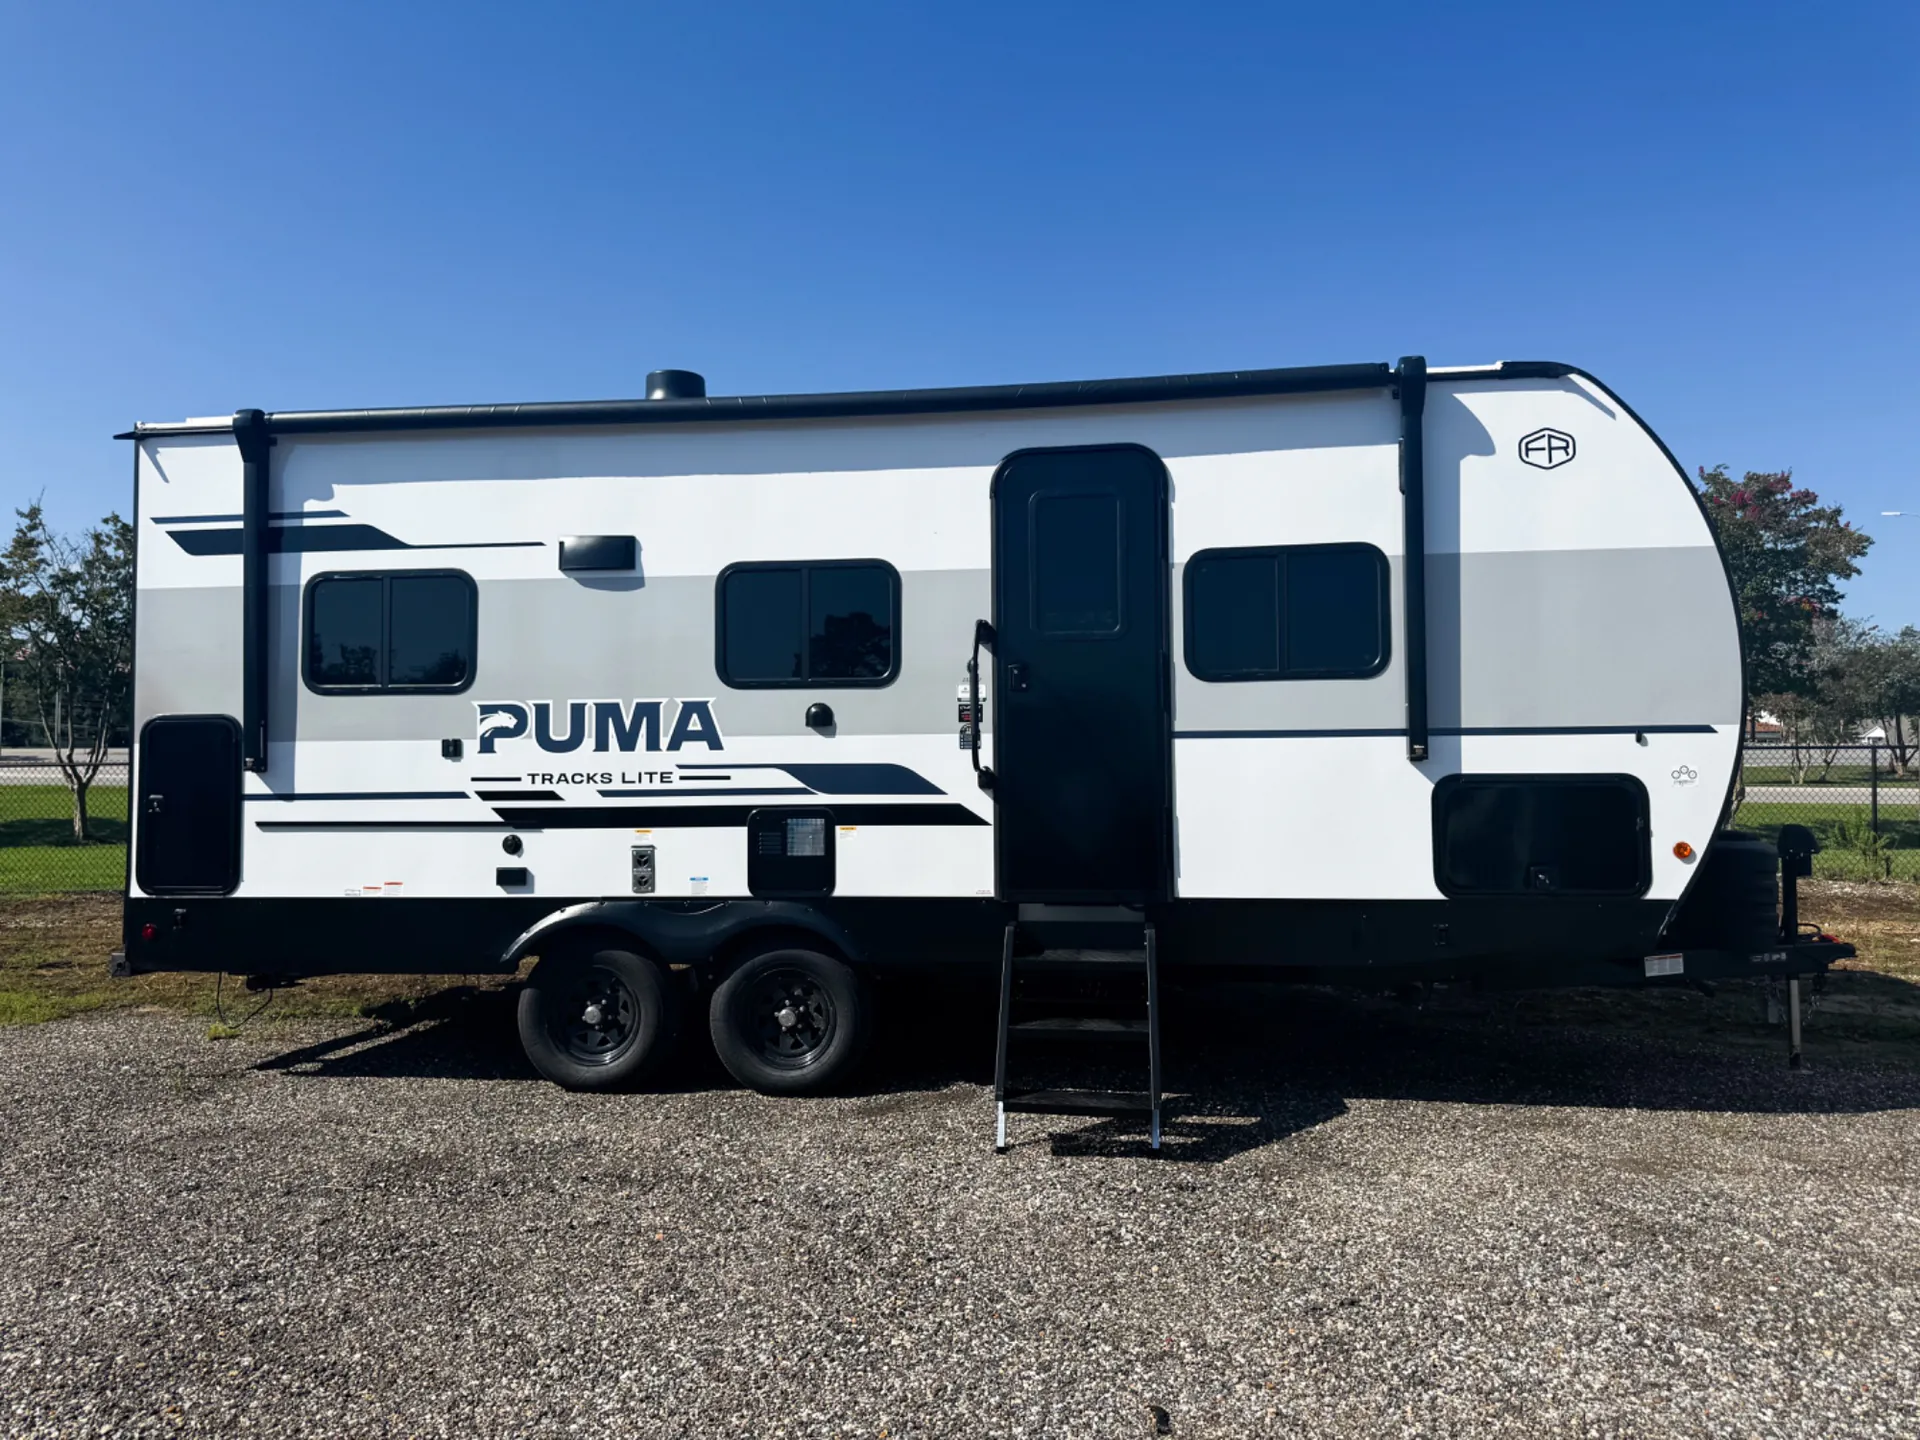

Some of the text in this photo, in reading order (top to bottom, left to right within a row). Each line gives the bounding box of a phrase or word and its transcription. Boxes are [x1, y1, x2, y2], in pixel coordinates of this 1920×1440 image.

[1524, 433, 1570, 464] FR
[474, 699, 725, 754] PUMA
[527, 771, 674, 785] TRACKS LITE
